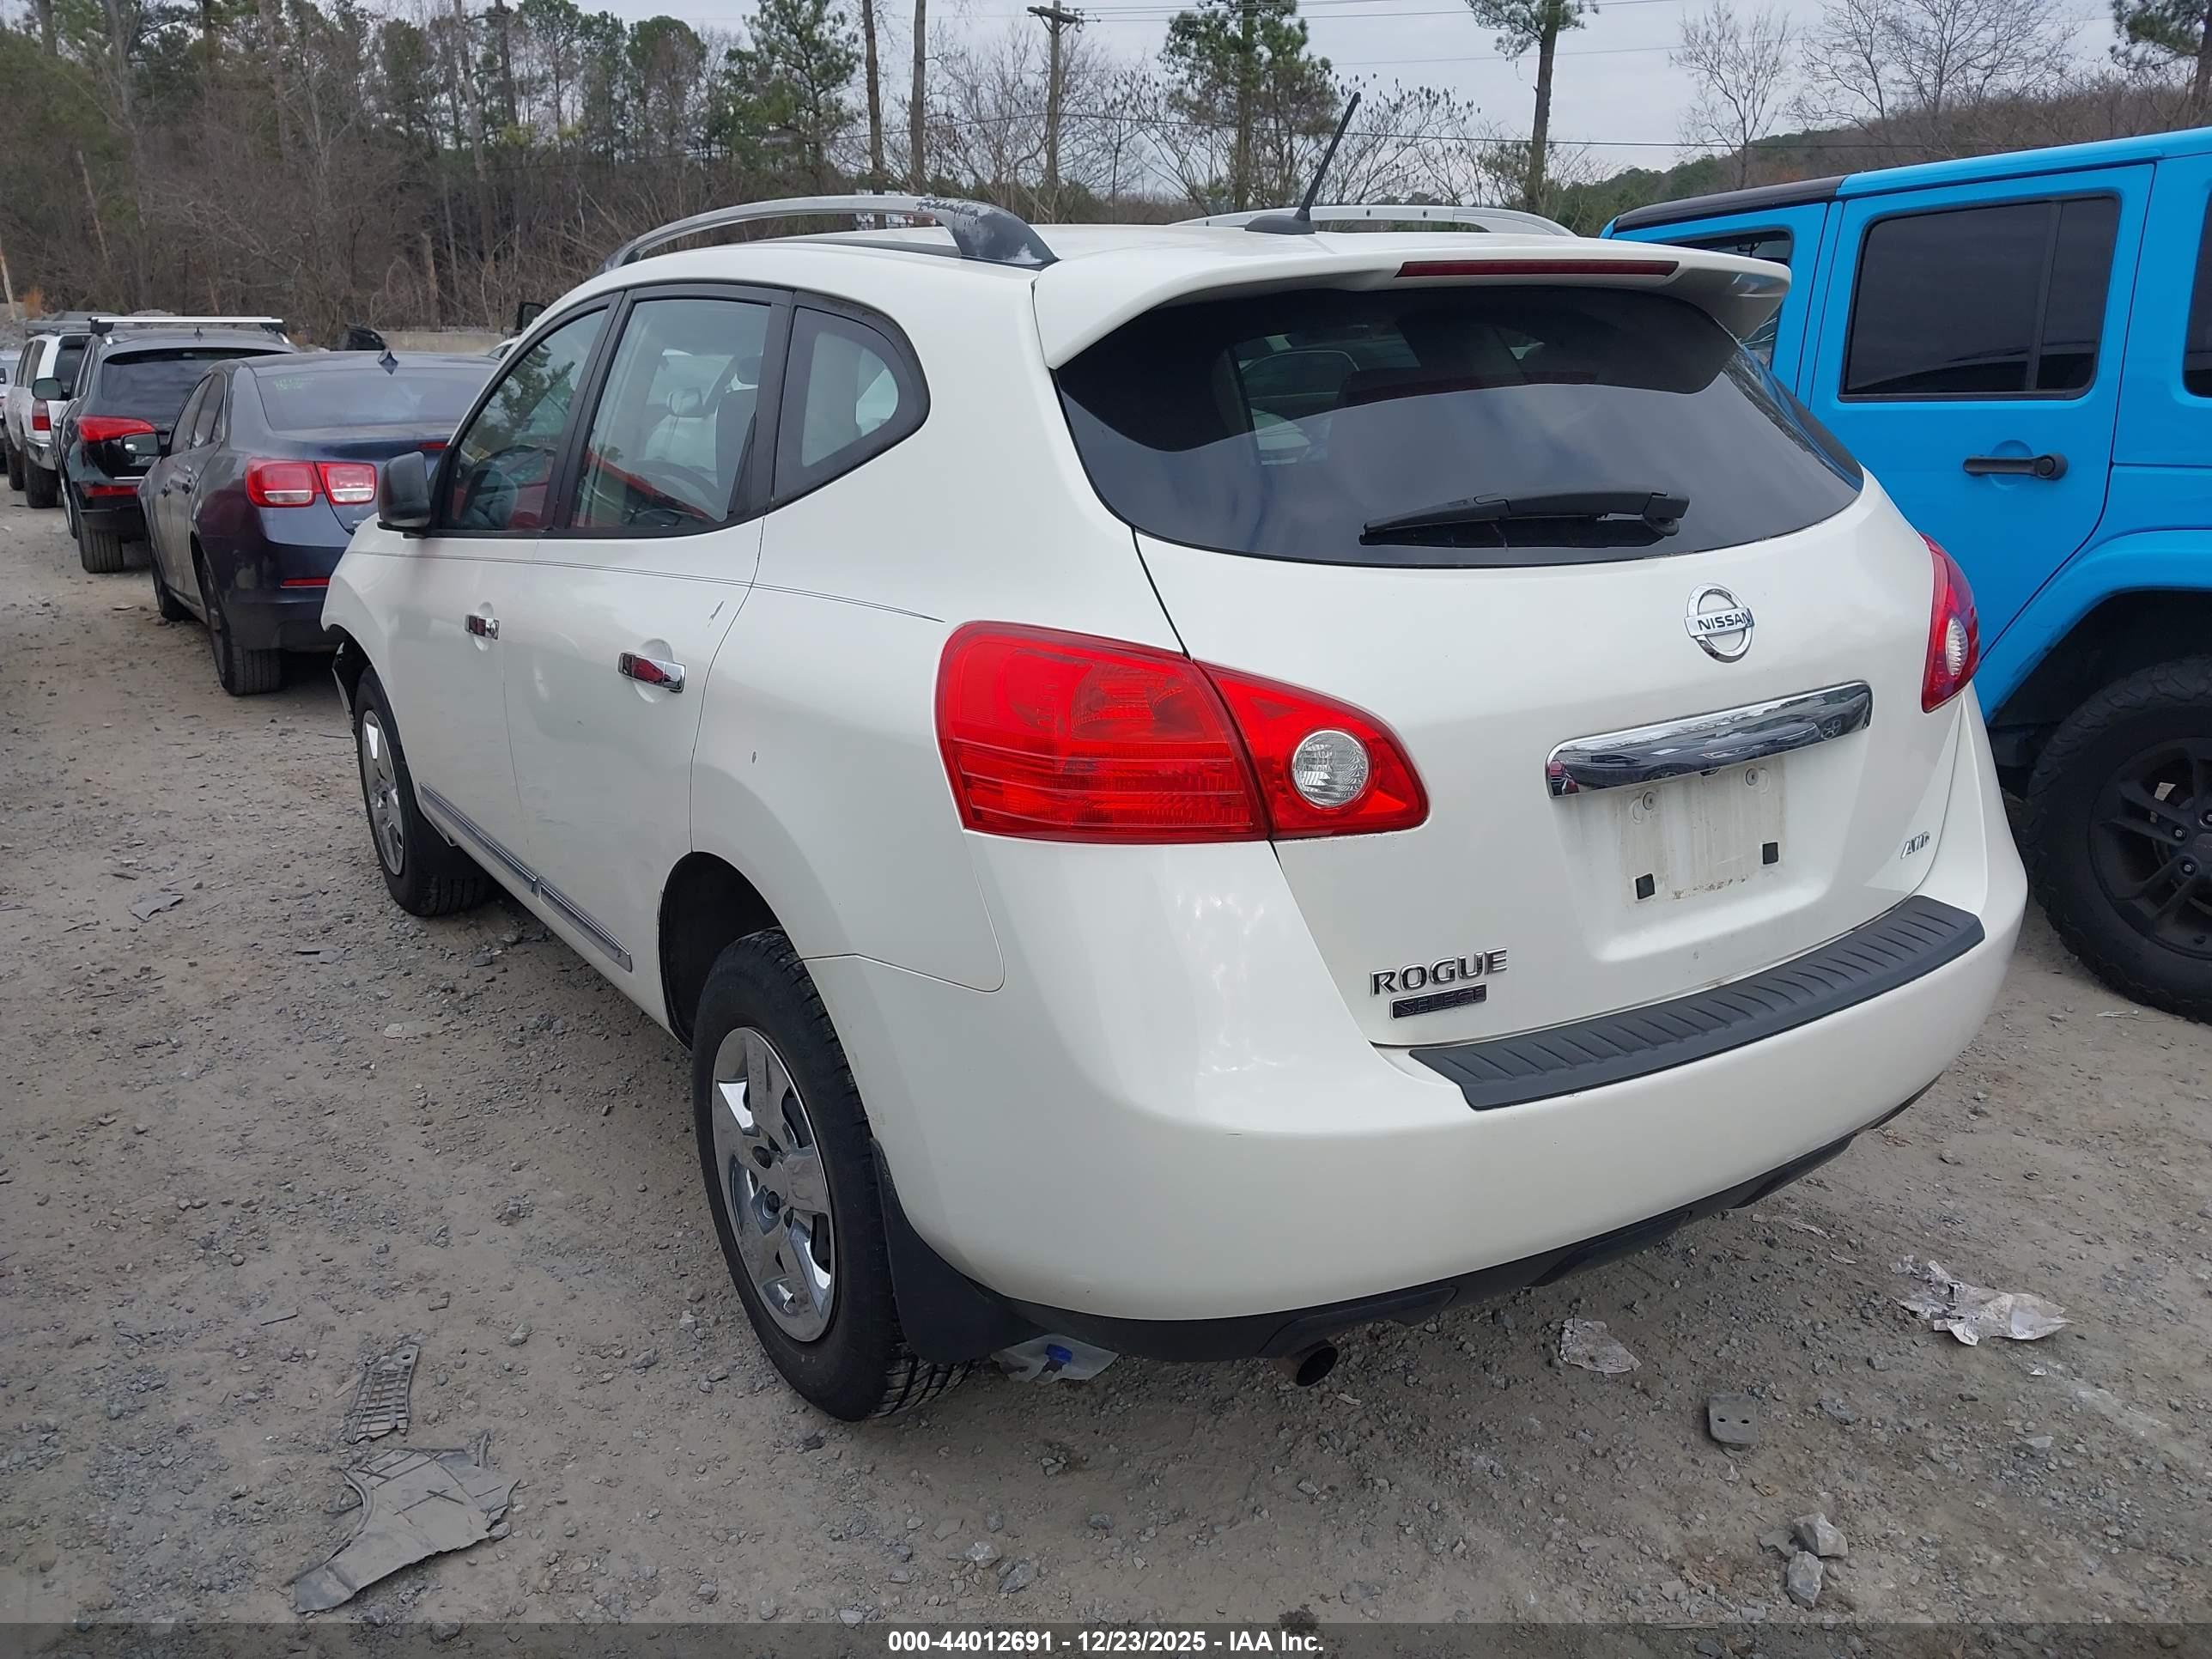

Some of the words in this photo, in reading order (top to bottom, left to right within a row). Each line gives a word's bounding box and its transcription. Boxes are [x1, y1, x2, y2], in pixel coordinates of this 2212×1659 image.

[1698, 611, 1751, 631] NISSAN
[1370, 947, 1508, 996] ROGUE
[1395, 988, 1483, 1016] SELECT
